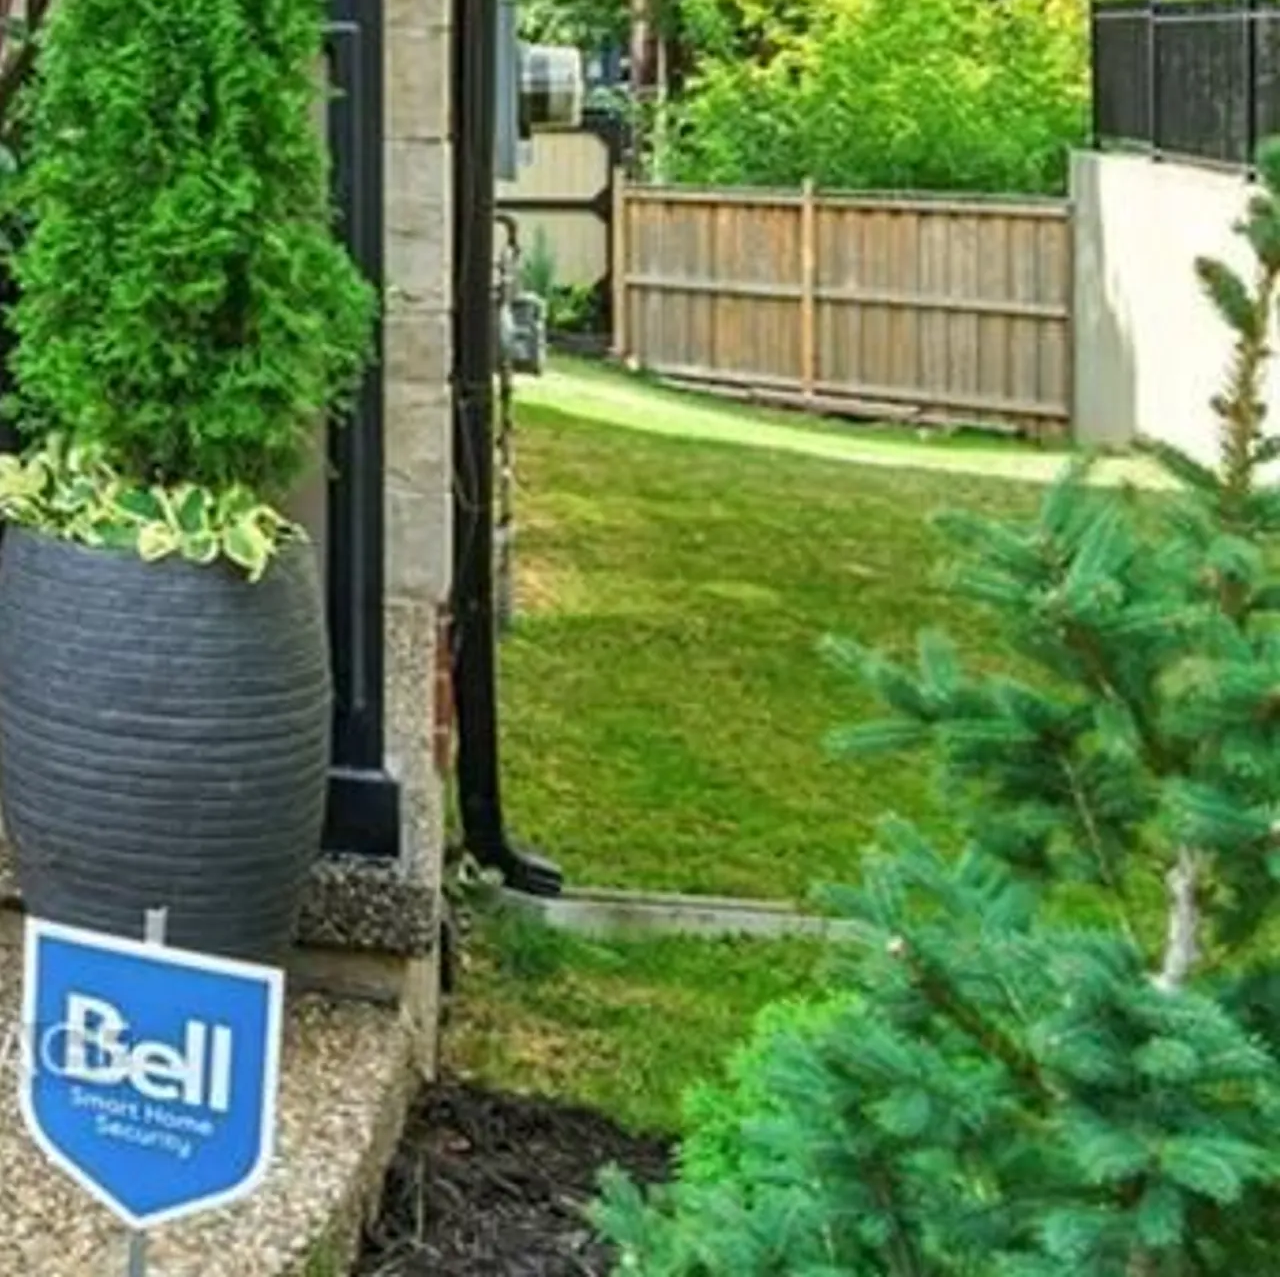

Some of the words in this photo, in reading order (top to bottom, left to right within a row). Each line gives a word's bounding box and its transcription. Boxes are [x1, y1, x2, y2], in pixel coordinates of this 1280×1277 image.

[65, 992, 232, 1113] Bell
[70, 1085, 139, 1121] Smart
[143, 1102, 214, 1137] Home
[95, 1115, 192, 1159] Security
